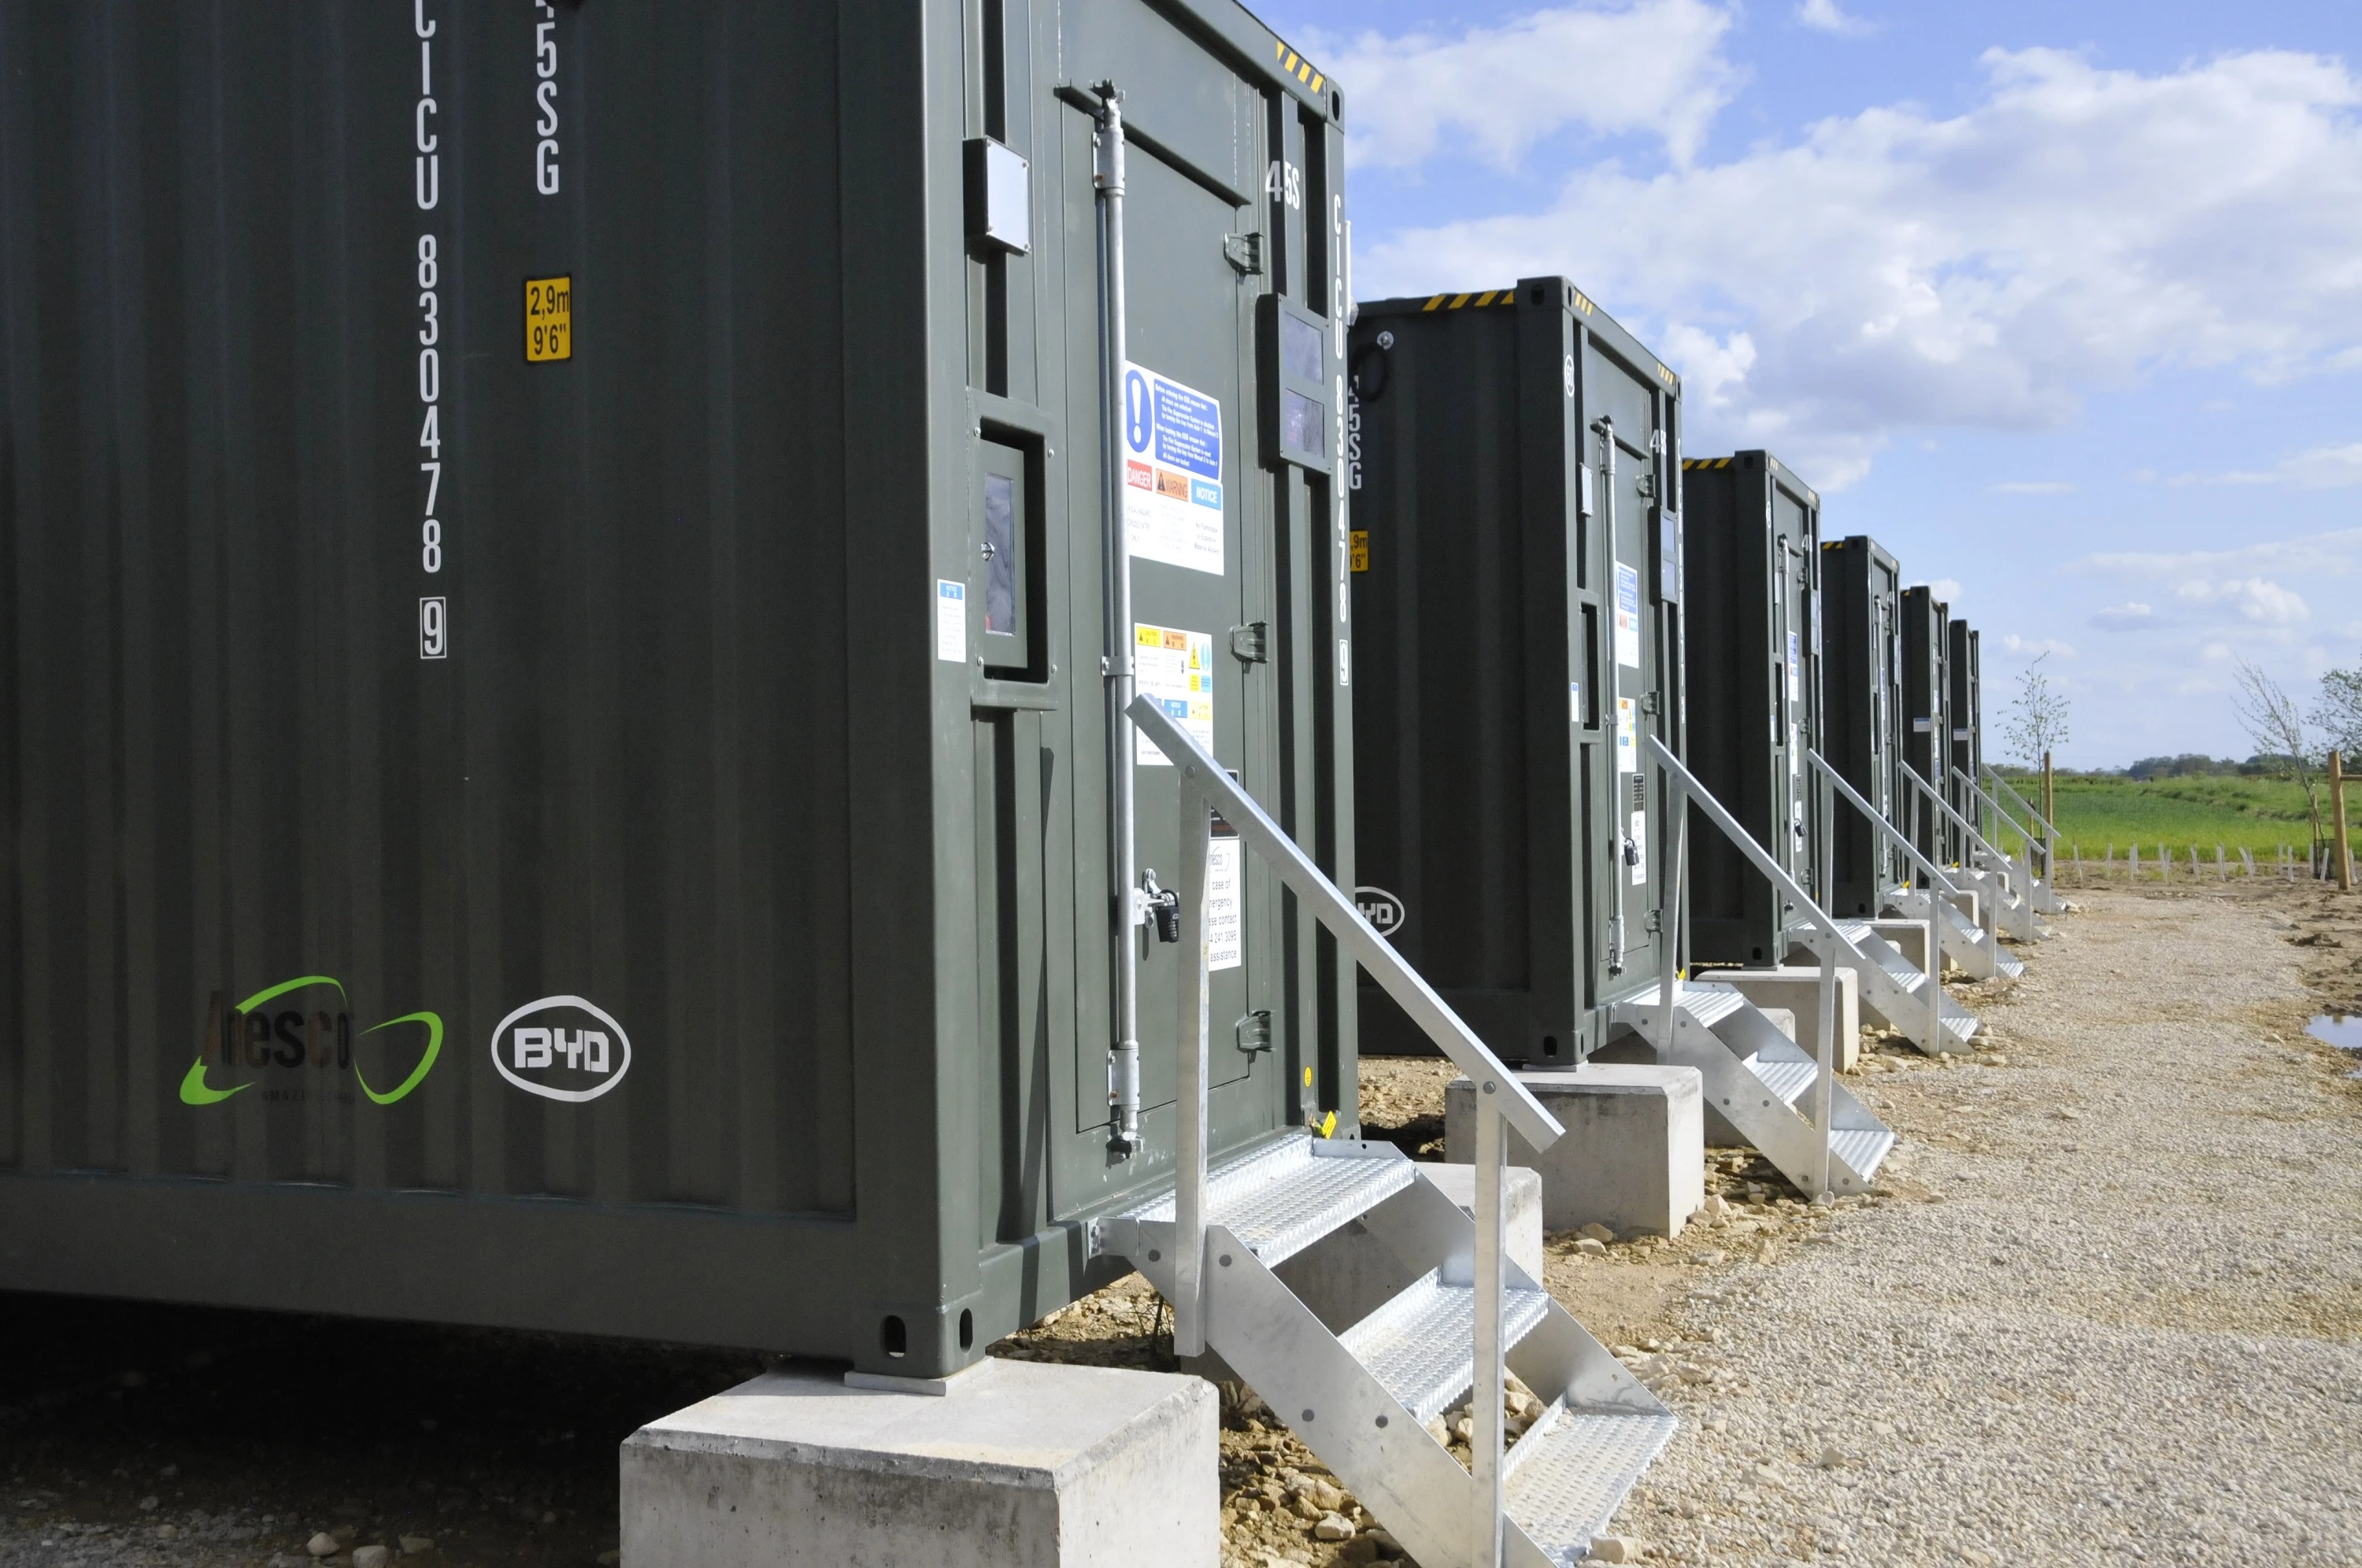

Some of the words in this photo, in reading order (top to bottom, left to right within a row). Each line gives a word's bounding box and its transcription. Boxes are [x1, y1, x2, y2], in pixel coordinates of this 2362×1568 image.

[535, 0, 559, 195] 5SG
[1334, 194, 1343, 360] CICU
[530, 284, 569, 320] 2,9m
[418, 234, 441, 573] 830478
[1127, 467, 1151, 489] DANGER
[1165, 478, 1188, 498] WARNING
[1196, 485, 1218, 504] NOTICE
[1336, 374, 1347, 623] 830478
[423, 601, 443, 656] 9
[1209, 854, 1223, 865] nesco
[1212, 881, 1224, 890] case
[1225, 878, 1231, 889] of
[1219, 914, 1237, 925] contact
[1357, 902, 1394, 924] YD
[1214, 932, 1223, 943] 241
[1209, 949, 1237, 962] assistance
[514, 1027, 609, 1073] BYD
